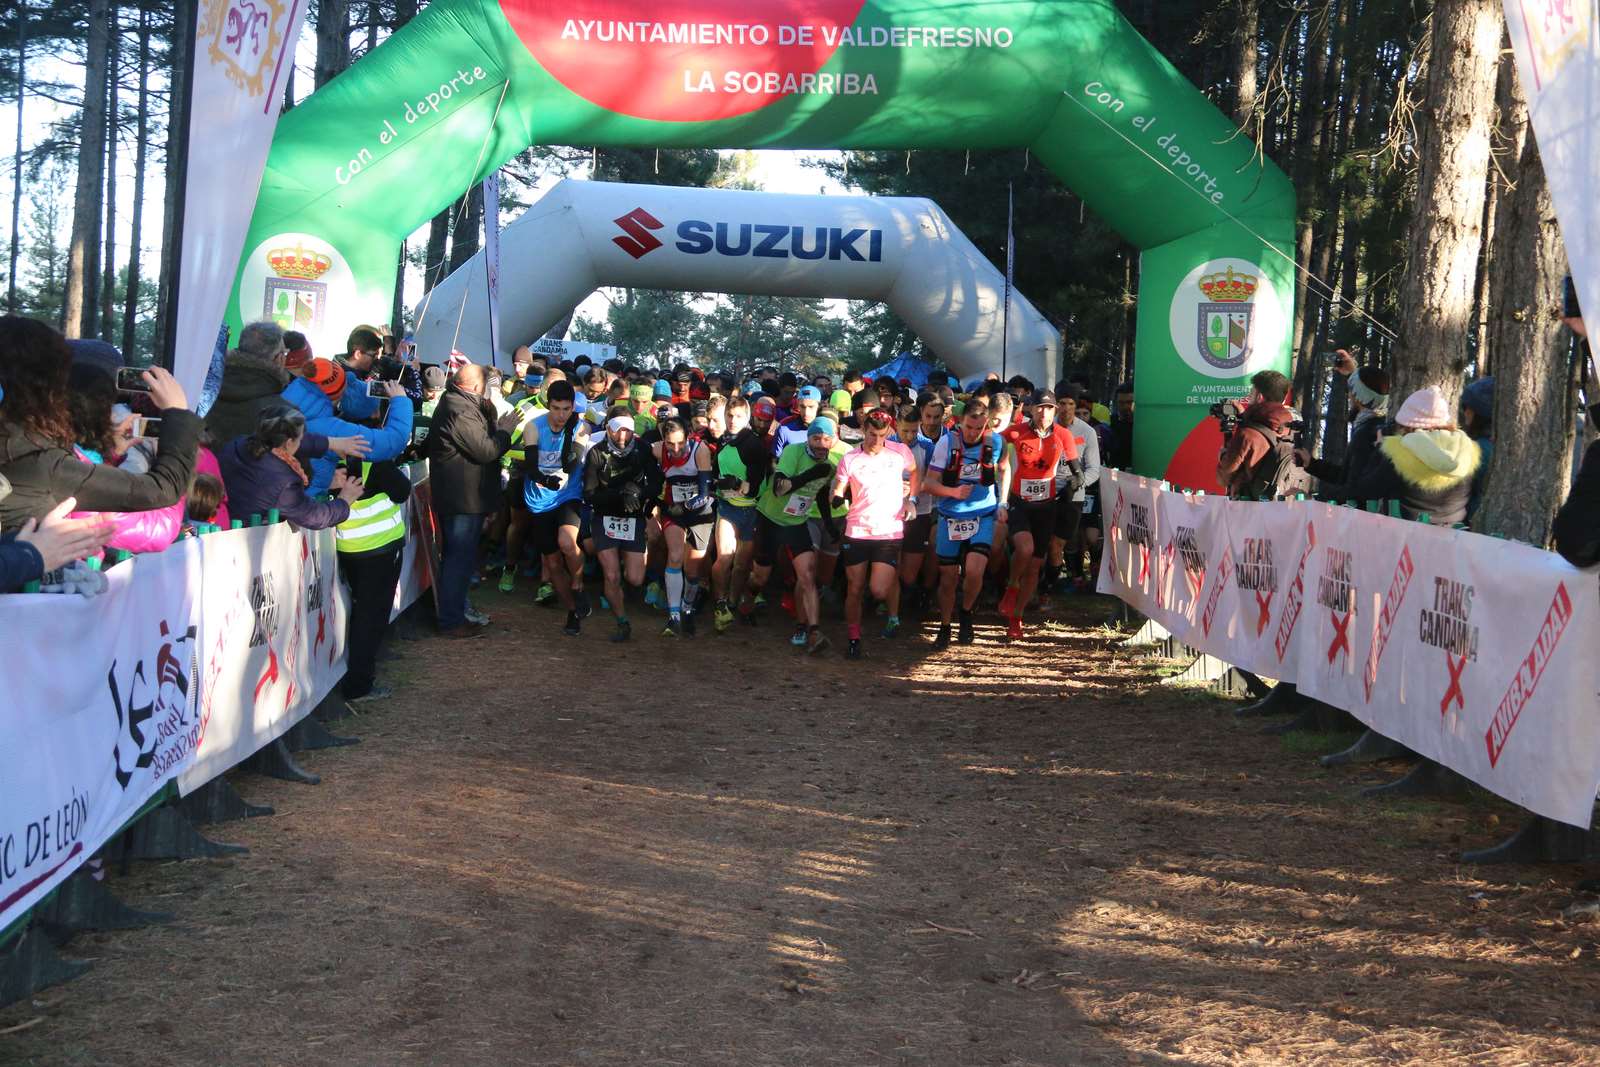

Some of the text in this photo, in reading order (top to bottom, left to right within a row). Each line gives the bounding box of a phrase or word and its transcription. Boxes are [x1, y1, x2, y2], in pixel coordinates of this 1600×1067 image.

[560, 19, 1013, 48] AYUNTAMIENTO DE VALDEFRESNO
[684, 70, 878, 96] LA SOBARRIBA
[335, 66, 487, 185] Con el deporte
[1084, 82, 1224, 204] Con el deporte
[675, 219, 882, 262] SUZUKI
[1186, 396, 1199, 404] DE
[1191, 385, 1253, 394] AYUNTAMIENT
[1026, 486, 1046, 494] 485
[608, 522, 630, 532] 413
[954, 522, 975, 532] 463
[1434, 576, 1475, 622] TRANS
[1419, 608, 1480, 662] CANDAMIA
[24, 815, 50, 869] DE
[56, 785, 90, 852] LEÓN
